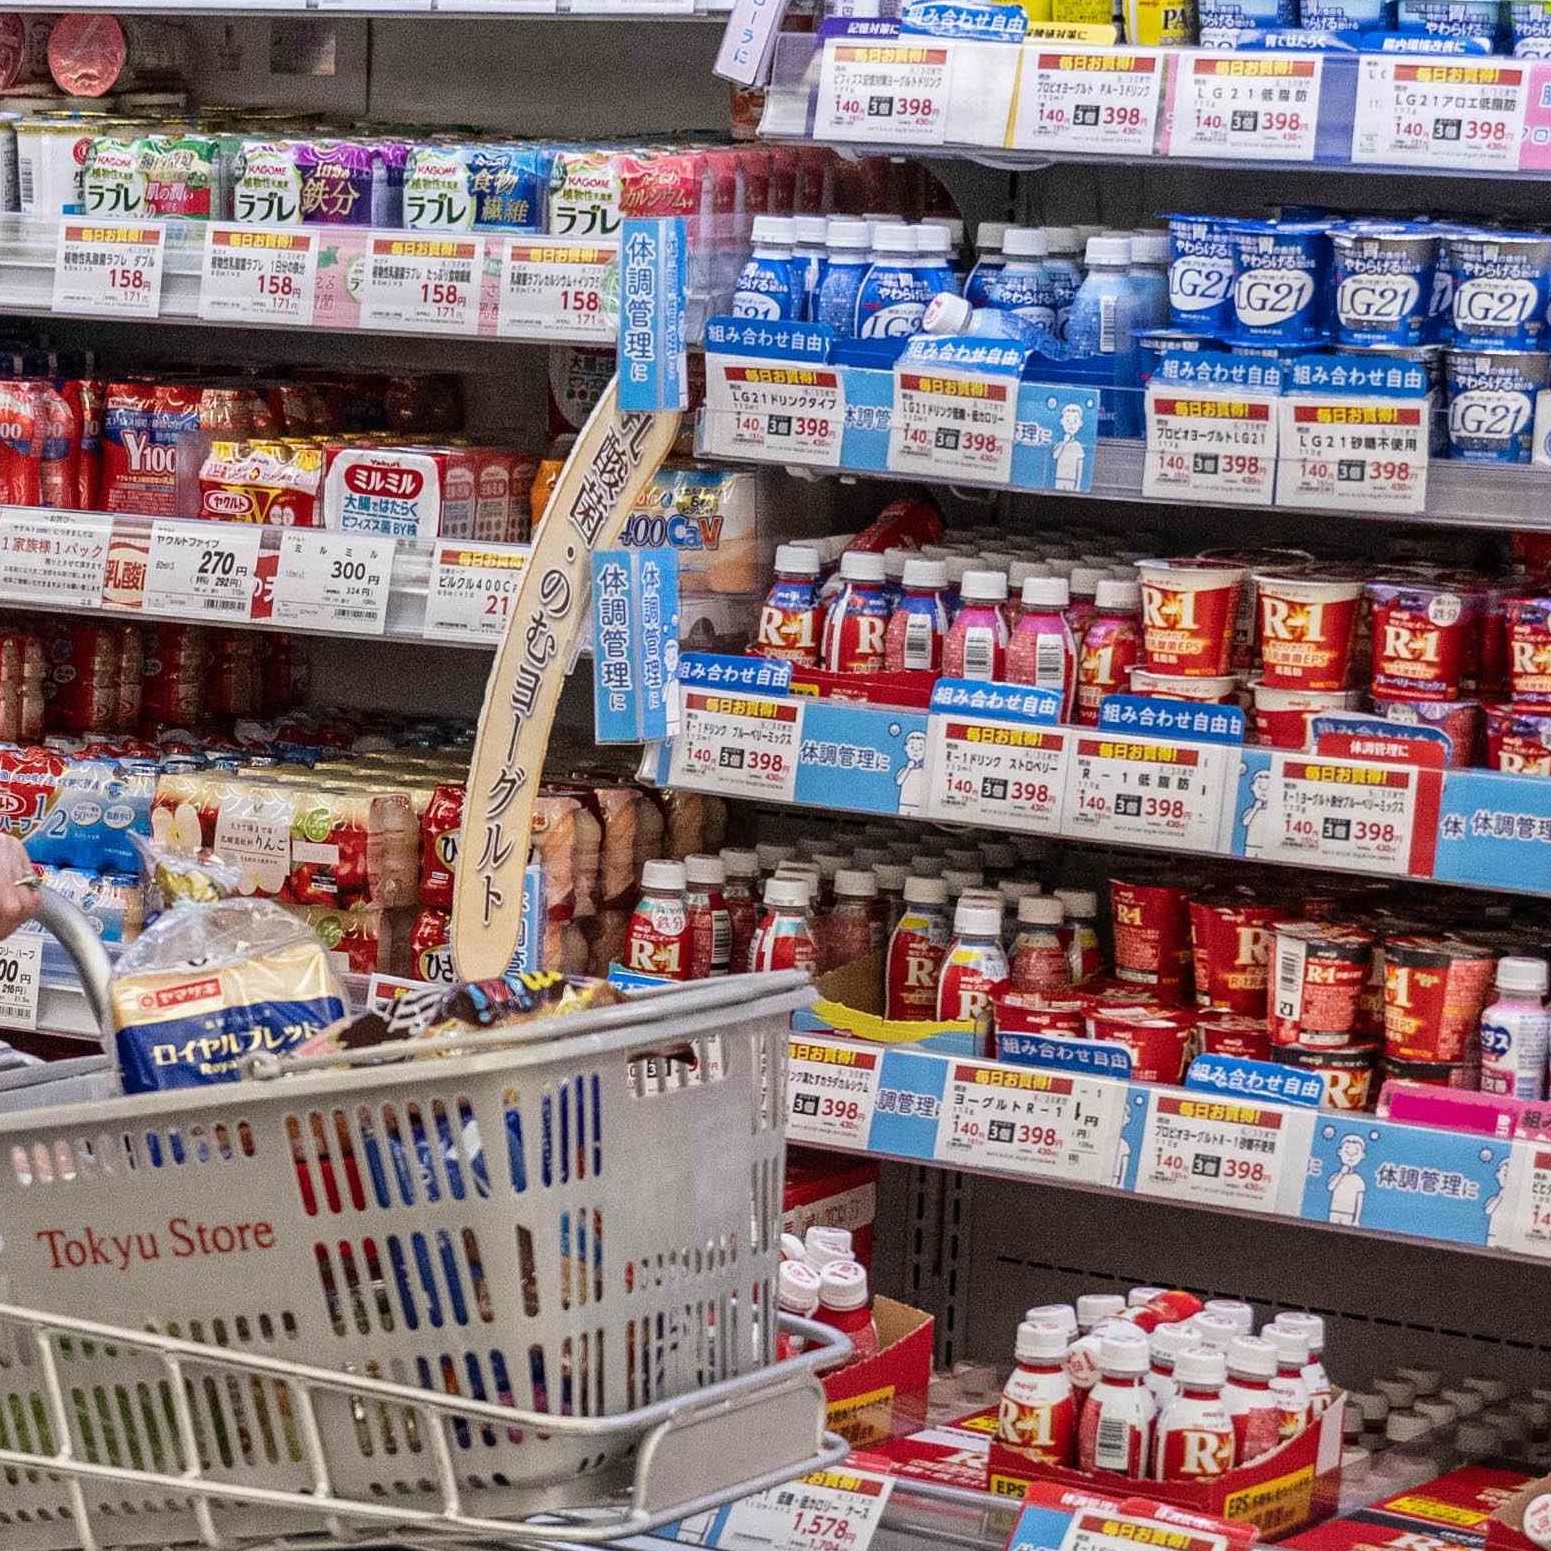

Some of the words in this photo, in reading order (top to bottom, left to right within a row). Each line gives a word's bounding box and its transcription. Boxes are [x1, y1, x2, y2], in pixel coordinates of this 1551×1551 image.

[896, 98, 940, 116] 398円
[1103, 106, 1148, 126] 398円
[1261, 112, 1308, 132] 398円
[244, 165, 288, 176] KAGOME
[88, 184, 141, 214] ラブレ
[238, 192, 297, 224] ラブレ
[302, 180, 360, 213] 鉄分
[406, 196, 466, 226] ラブレ
[556, 205, 620, 235] ラブレ
[256, 276, 300, 296] 158円
[625, 234, 655, 383] 体調管理に
[706, 324, 826, 353] 組み合わせ自由
[1294, 364, 1422, 390] 組み合わせ自由
[794, 418, 835, 437] 398円
[352, 470, 416, 494] ミルミル
[1369, 461, 1417, 481] 398円
[344, 496, 418, 516] 大腸ではたらく
[199, 552, 248, 576] 270円
[332, 561, 380, 584] 300円
[1142, 589, 1197, 629] R-1
[1262, 599, 1324, 643] R-1
[599, 564, 629, 711] 体調管理に
[759, 607, 814, 646] R-1
[1383, 623, 1439, 663] R-1
[678, 656, 790, 687] 組み合わせ自由
[748, 751, 789, 773] 398円
[801, 739, 891, 772] 体調管理に
[1375, 1163, 1479, 1199] 体調管理に
[33, 1226, 160, 1270] Tokyu
[168, 1218, 276, 1258] Store
